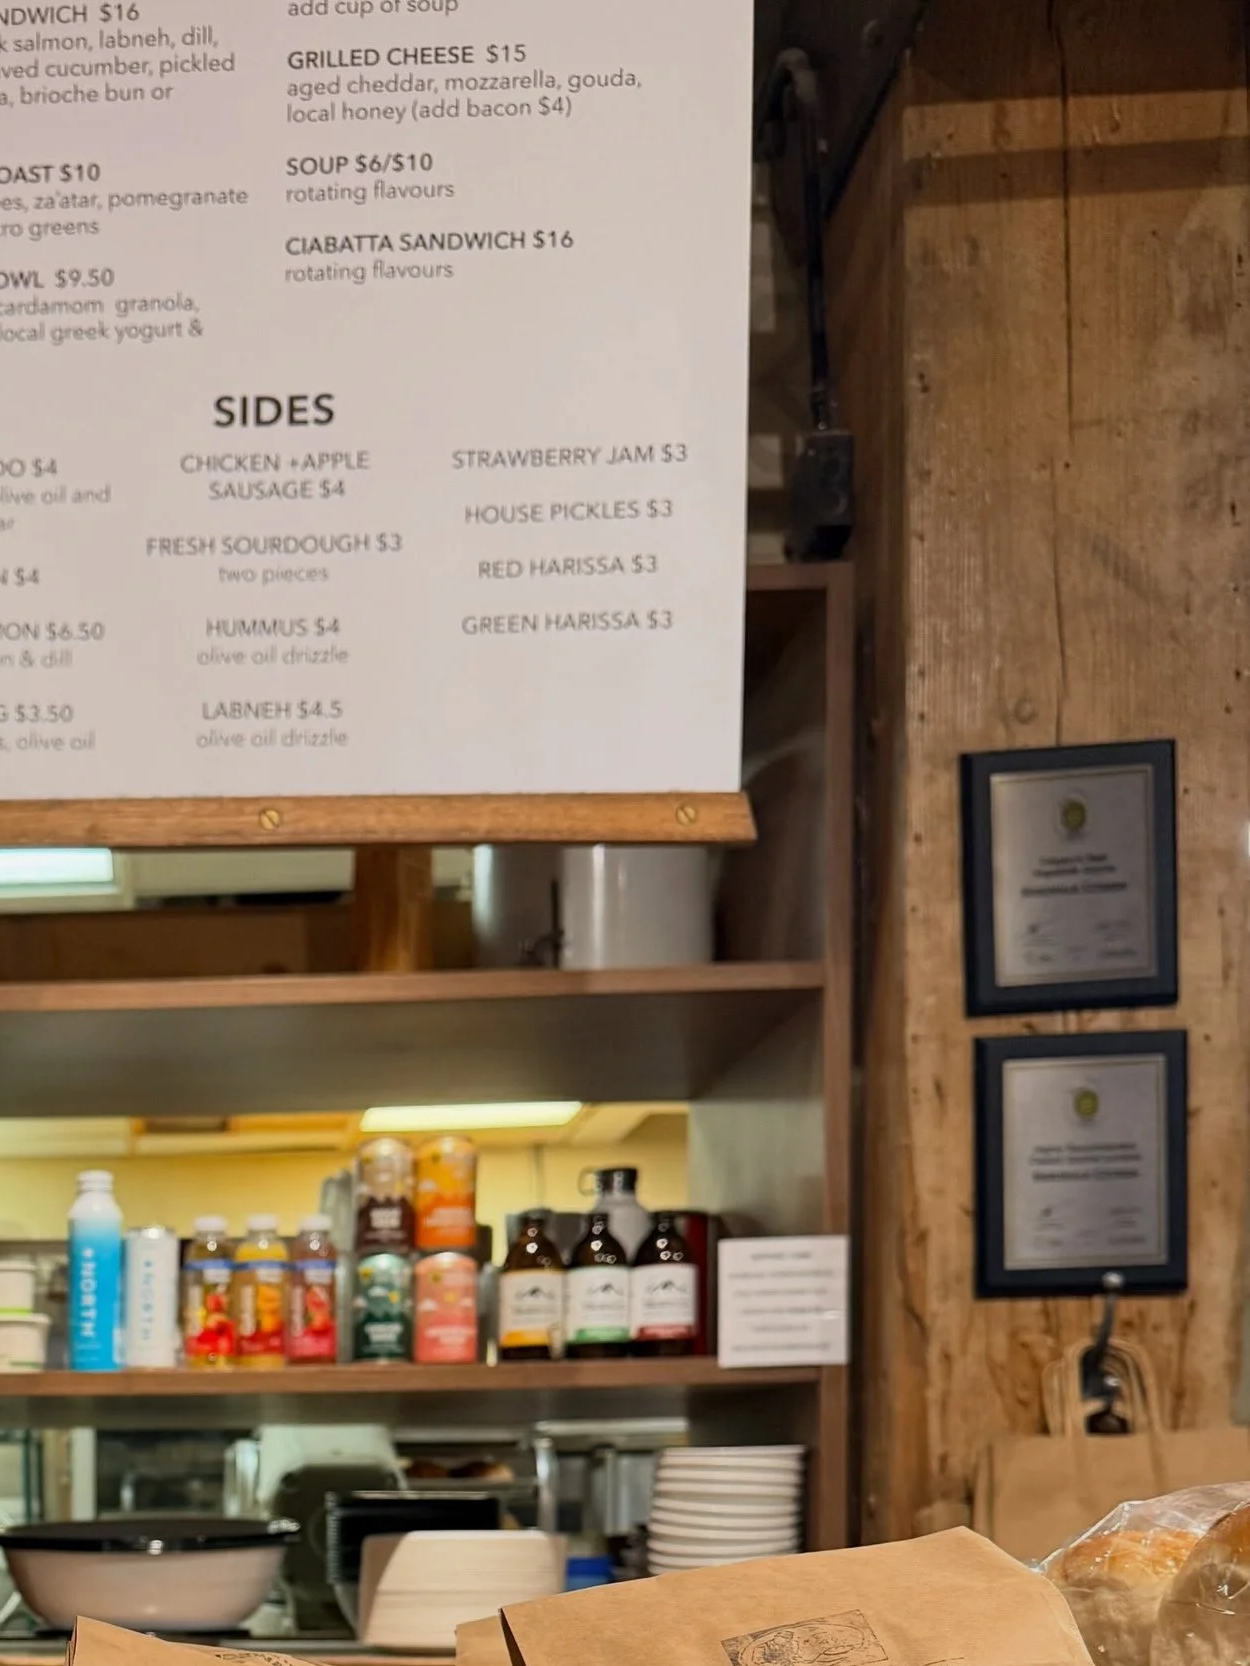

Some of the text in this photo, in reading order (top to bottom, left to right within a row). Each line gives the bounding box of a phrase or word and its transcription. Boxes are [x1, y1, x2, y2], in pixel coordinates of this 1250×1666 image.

[100, 3, 139, 23] $16
[13, 32, 93, 52] salmon,
[99, 27, 175, 50] labneh,
[181, 25, 218, 48] dill,
[45, 56, 153, 78] cucumber,
[159, 52, 235, 78] pickled
[288, 44, 526, 70] GRILLED CHEESE $15
[20, 84, 99, 104] brioche
[105, 82, 145, 102] bun
[150, 86, 174, 100] or
[287, 68, 641, 101] aged cheddar, mozzarella, gouda,
[287, 95, 571, 124] local honey (add bacon $4)
[60, 163, 100, 183] $10
[287, 152, 433, 176] SOUP $6/$10
[33, 190, 102, 210] za'atar,
[108, 189, 248, 212] pomegranate
[286, 178, 454, 205] rotating flavours
[28, 221, 100, 242] greens
[286, 230, 573, 255] CIABATTA SANDWICH $16
[55, 268, 114, 289] $9.50
[285, 258, 454, 285] rotating flavours
[115, 292, 199, 318] granola,
[50, 320, 110, 346] greek
[114, 321, 182, 344] yogurt
[188, 318, 203, 337] &
[214, 393, 334, 428] SIDES
[180, 453, 281, 473] CHICKEN
[452, 444, 687, 469] STRAWBERRY JAM $3
[32, 458, 57, 478] $4
[209, 478, 345, 500] SAUSAGE $4
[465, 499, 673, 525] HOUSE PICKLES $3
[146, 532, 402, 556] FRESH SOURDOUGH $3
[14, 567, 39, 586] $4
[218, 565, 329, 586] two pieces
[479, 554, 657, 579] RED HARISSA $3
[46, 622, 105, 642] $6.50
[206, 617, 340, 637] HUMMUS $4
[462, 610, 672, 635] GREEN HARISSA $3
[19, 649, 35, 668] &
[40, 648, 73, 669] dill
[197, 644, 349, 665] olive oil drizzle
[15, 703, 74, 723] $3.50
[202, 699, 343, 720] LABNEH $4.5
[15, 730, 66, 751] olive
[69, 730, 95, 751] oil
[196, 727, 348, 749] olive oil drizzle
